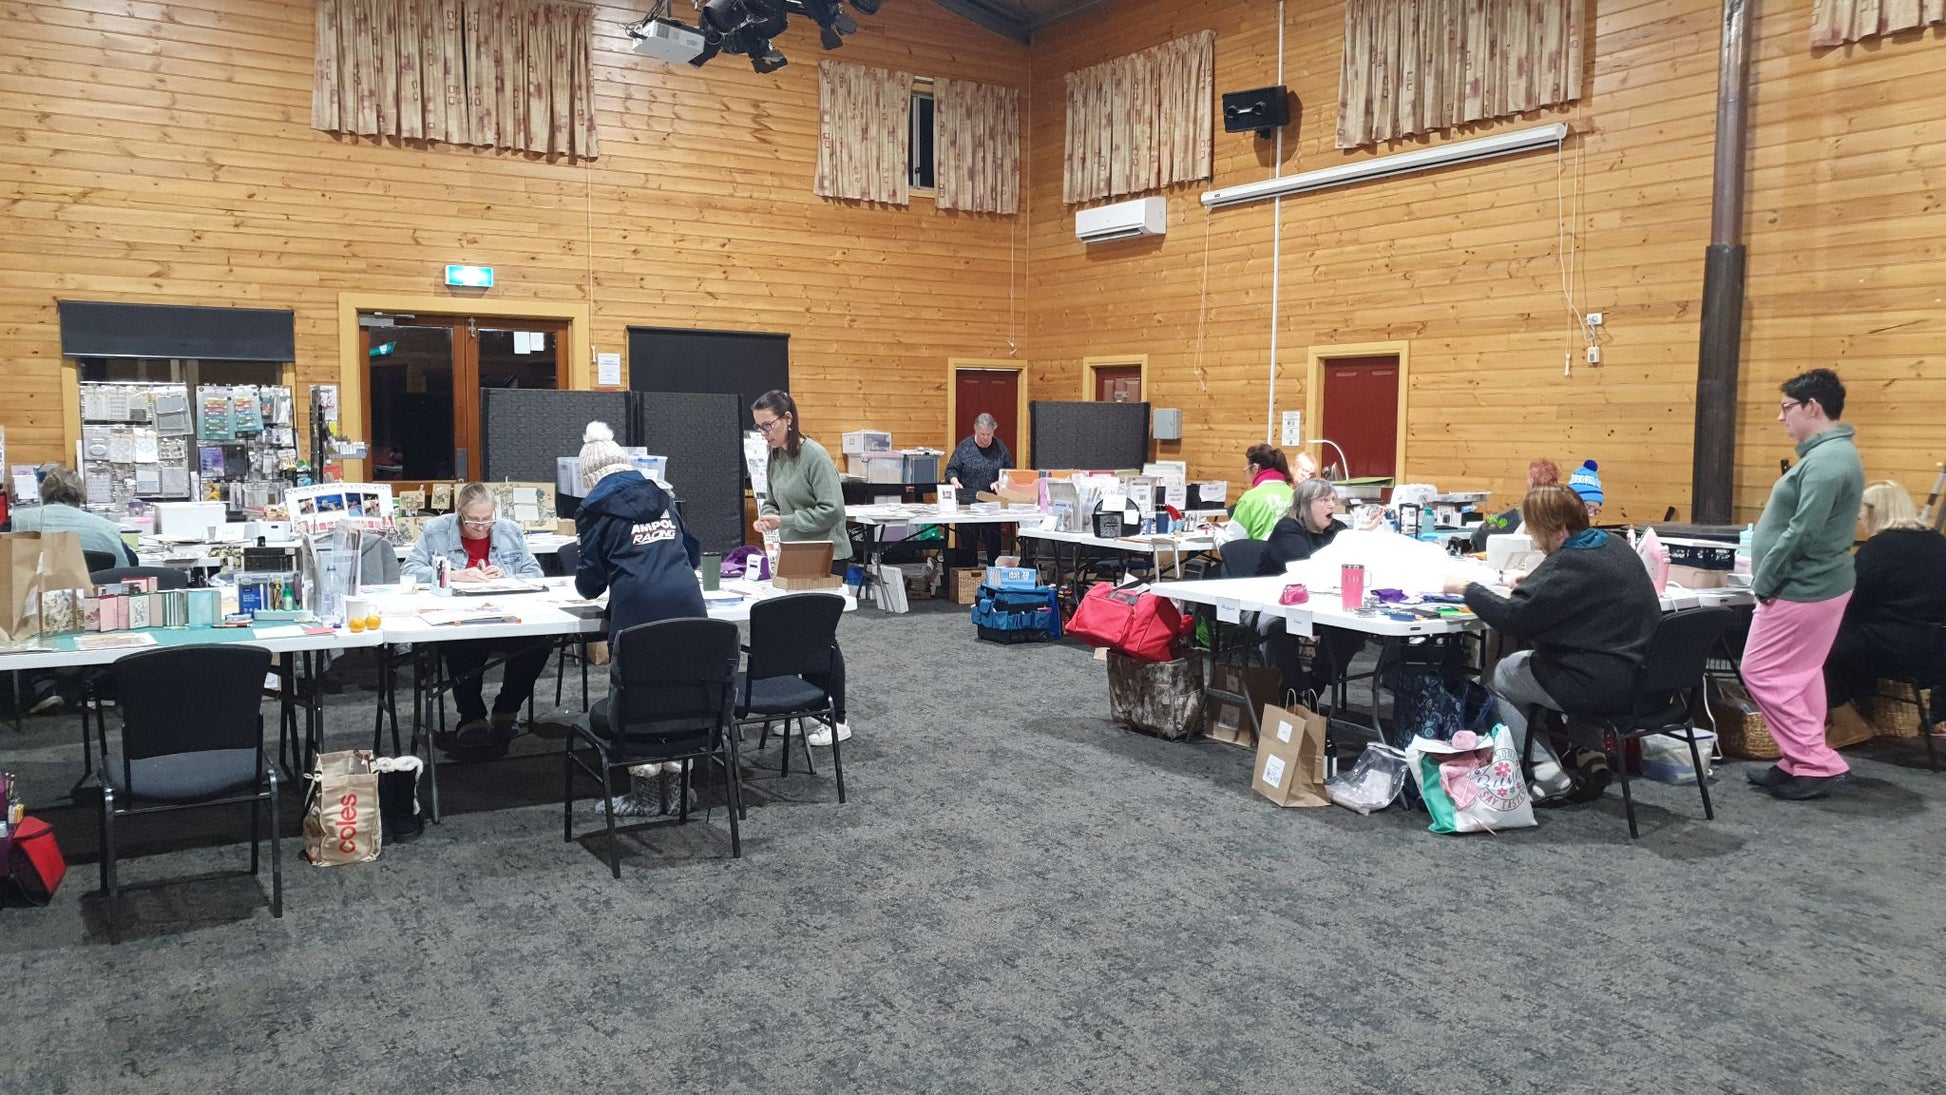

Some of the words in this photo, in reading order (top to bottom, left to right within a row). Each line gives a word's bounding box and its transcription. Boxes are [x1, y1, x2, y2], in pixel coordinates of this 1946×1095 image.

[631, 519, 676, 535] AMPOL
[633, 530, 676, 545] RACING
[1479, 791, 1498, 805] SAY
[335, 793, 358, 854] coles
